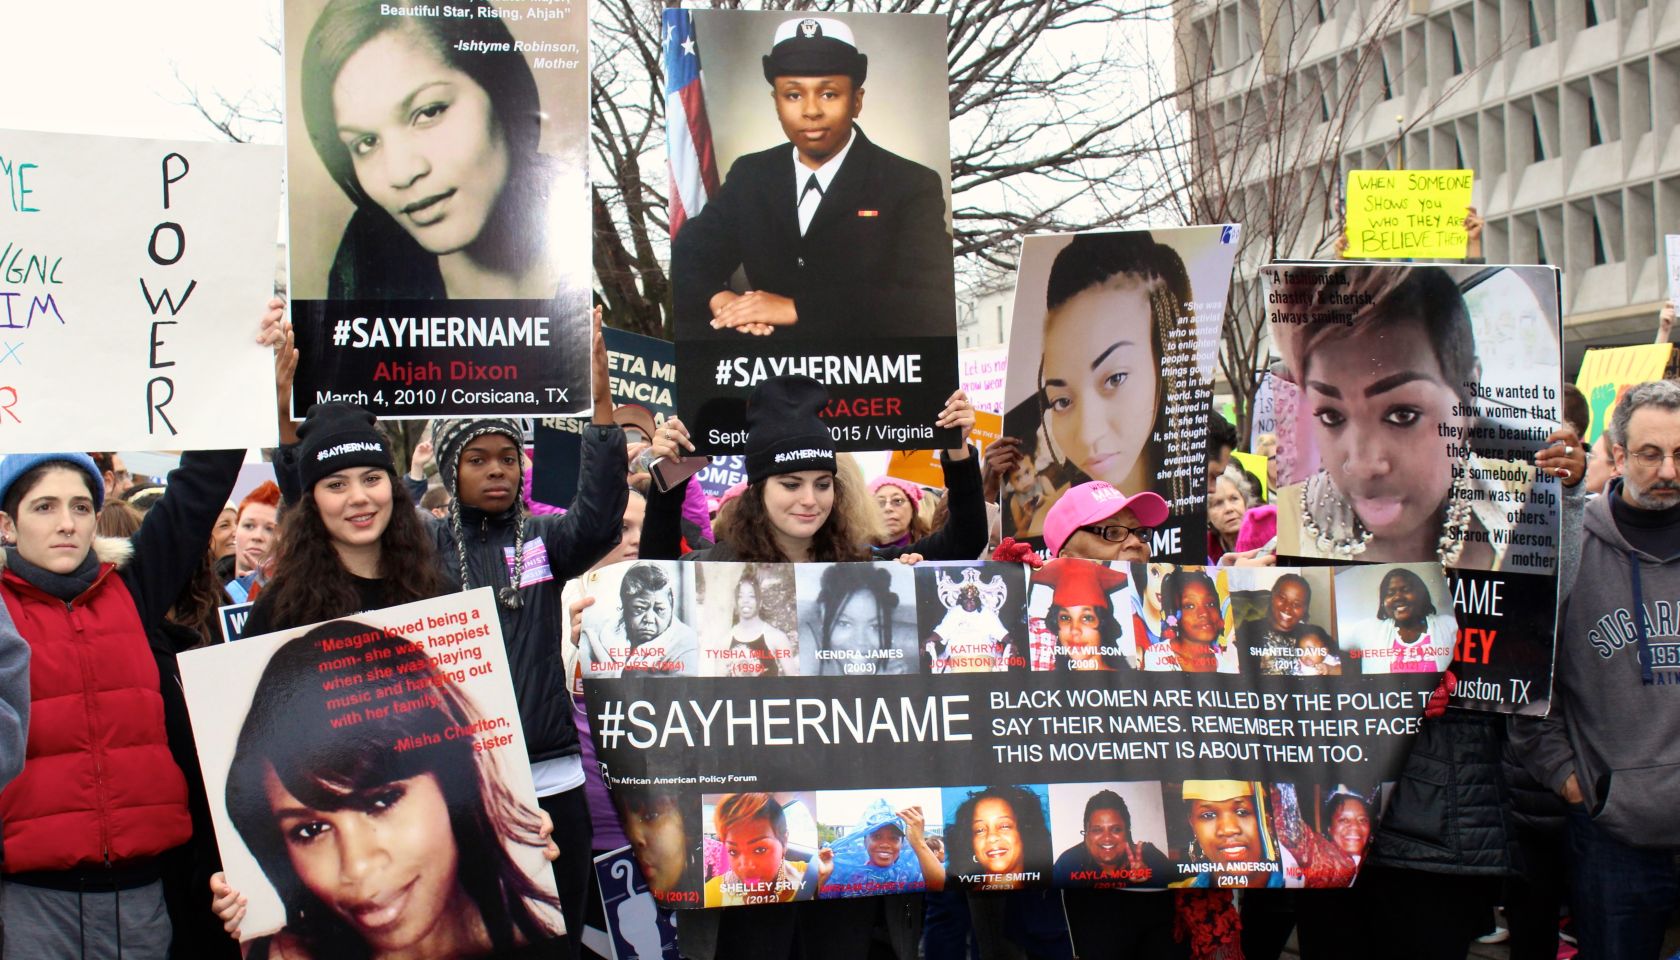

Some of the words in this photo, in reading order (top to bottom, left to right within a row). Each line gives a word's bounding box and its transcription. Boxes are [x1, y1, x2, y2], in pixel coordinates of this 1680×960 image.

[380, 4, 440, 17] Beautiful
[443, 5, 474, 19] Star,
[477, 6, 522, 20] Rising,
[526, 7, 571, 21] Ahjah"
[454, 40, 510, 54] -Ishtyme
[514, 40, 580, 54] Robinson,
[534, 58, 580, 70] Mother
[1358, 176, 1395, 190] WHEN
[1408, 174, 1471, 190] SOMEONE
[1364, 195, 1408, 212] SHOWS
[1418, 198, 1442, 212] YOU
[1368, 218, 1399, 228] WHO
[1407, 215, 1441, 228] THEY
[1446, 216, 1465, 226] ARE
[1362, 230, 1430, 252] BELIEVE
[139, 153, 197, 435] POWER
[1330, 290, 1376, 307] cherish,
[1190, 314, 1220, 323] activist
[1272, 309, 1309, 326] always
[1312, 309, 1358, 326] smiling"
[333, 316, 550, 348] #SAYHERNAME
[1169, 329, 1186, 338] who
[1188, 326, 1218, 336] wanted
[1168, 342, 1176, 350] to
[1178, 340, 1216, 350] enlighten
[1162, 354, 1189, 366] people
[1191, 352, 1214, 361] about
[373, 361, 442, 386] Ahjah
[450, 361, 518, 380] Dixon
[1162, 367, 1188, 377] things
[1190, 366, 1213, 376] going
[1188, 378, 1197, 386] in
[1199, 378, 1212, 386] the
[373, 390, 388, 408] 4,
[394, 389, 436, 405] 2010
[440, 388, 446, 404] /
[452, 388, 540, 406] Corsicana,
[545, 388, 568, 403] TX
[1167, 391, 1192, 401] world.
[1195, 390, 1210, 399] She
[1463, 382, 1492, 398] "She
[1496, 385, 1538, 400] wanted
[1543, 386, 1556, 400] to
[1165, 404, 1199, 414] believed
[1202, 402, 1208, 411] in
[1452, 402, 1481, 417] show
[1486, 406, 1527, 420] women
[1532, 405, 1556, 421] that
[1178, 416, 1193, 426] she
[1195, 415, 1208, 424] felt
[875, 424, 934, 443] Virginia
[1154, 432, 1162, 443] it,
[1164, 430, 1178, 440] she
[1180, 428, 1207, 440] fought
[1438, 423, 1463, 440] they
[1467, 426, 1496, 440] were
[316, 442, 382, 460] #SAYHERNAME
[1168, 443, 1179, 452] for
[1181, 442, 1189, 452] it,
[1191, 440, 1206, 450] and
[1447, 443, 1472, 460] they
[1476, 446, 1505, 460] were
[775, 448, 833, 463] #SAYHERNAME
[1164, 452, 1205, 466] eventually
[1157, 470, 1172, 480] she
[1174, 467, 1191, 477] died
[1194, 466, 1205, 475] for
[1452, 462, 1465, 478] be
[1469, 465, 1532, 485] somebody.
[1176, 494, 1204, 506] mother
[1448, 482, 1484, 500] dream
[1488, 488, 1510, 502] was
[1514, 489, 1526, 504] to
[1530, 489, 1556, 508] help
[1507, 509, 1556, 526] others."
[1449, 526, 1490, 542] Sharon
[1493, 529, 1556, 549] Wilkerson,
[1512, 552, 1556, 568] mother
[314, 631, 380, 654] "Meagan
[384, 619, 424, 639] loved
[428, 612, 468, 630] being
[472, 609, 480, 620] a
[318, 655, 362, 672] mom-
[365, 646, 392, 662] she
[395, 641, 425, 656] was
[428, 624, 490, 648] happiest
[609, 647, 665, 658] ELEANOR
[706, 650, 746, 660] TYISHA
[750, 649, 791, 660] MILLER
[814, 649, 862, 660] KENDRA
[866, 648, 904, 660] JAMES
[1081, 646, 1121, 656] WILSON
[1250, 646, 1294, 657] SHANTEL
[1296, 646, 1328, 657] DAVIS
[322, 672, 363, 692] when
[366, 666, 393, 681] she
[396, 660, 425, 675] was
[428, 646, 482, 668] playing
[590, 660, 648, 672] BUMPURS
[843, 662, 876, 675] (2003)
[326, 691, 371, 710] music
[376, 680, 402, 699] and
[406, 668, 466, 692] hanging
[469, 661, 492, 680] out
[1510, 679, 1531, 704] TX
[990, 690, 1062, 710] BLACK
[1066, 690, 1148, 708] WOMEN
[1153, 690, 1193, 708] ARE
[1197, 690, 1260, 710] KILLED
[1264, 694, 1288, 710] BY
[1292, 694, 1332, 711] THE
[1337, 692, 1414, 711] POLICE
[330, 711, 362, 729] with
[366, 703, 390, 720] her
[598, 694, 973, 750] #SAYHERNAME
[992, 718, 1034, 736] SAY
[1038, 716, 1104, 735] THEIR
[1109, 716, 1187, 734] NAMES.
[1192, 716, 1295, 737] REMEMBER
[1298, 719, 1358, 737] THEIR
[394, 733, 441, 754] -Misha
[444, 716, 510, 740] Charlton,
[472, 732, 513, 752] sister
[992, 744, 1043, 764] THIS
[1050, 742, 1170, 762] MOVEMENT
[1176, 741, 1194, 759] IS
[1199, 742, 1261, 760] ABOUT
[1262, 744, 1314, 763] THEM
[1318, 744, 1369, 763] TOO.
[621, 776, 651, 785] African
[654, 776, 697, 784] American
[700, 774, 726, 785] Policy
[728, 774, 758, 782] Forum
[1070, 870, 1108, 880] KAYLA
[1177, 862, 1225, 874] TANISHA
[1226, 862, 1279, 872] ANDERSON
[958, 874, 1002, 884] YVETTE
[1005, 872, 1040, 882] SMITH
[1217, 876, 1248, 888] (2014)
[719, 882, 774, 893] SHELLEY
[666, 891, 700, 903] (2012)
[746, 894, 780, 905] (2012)
